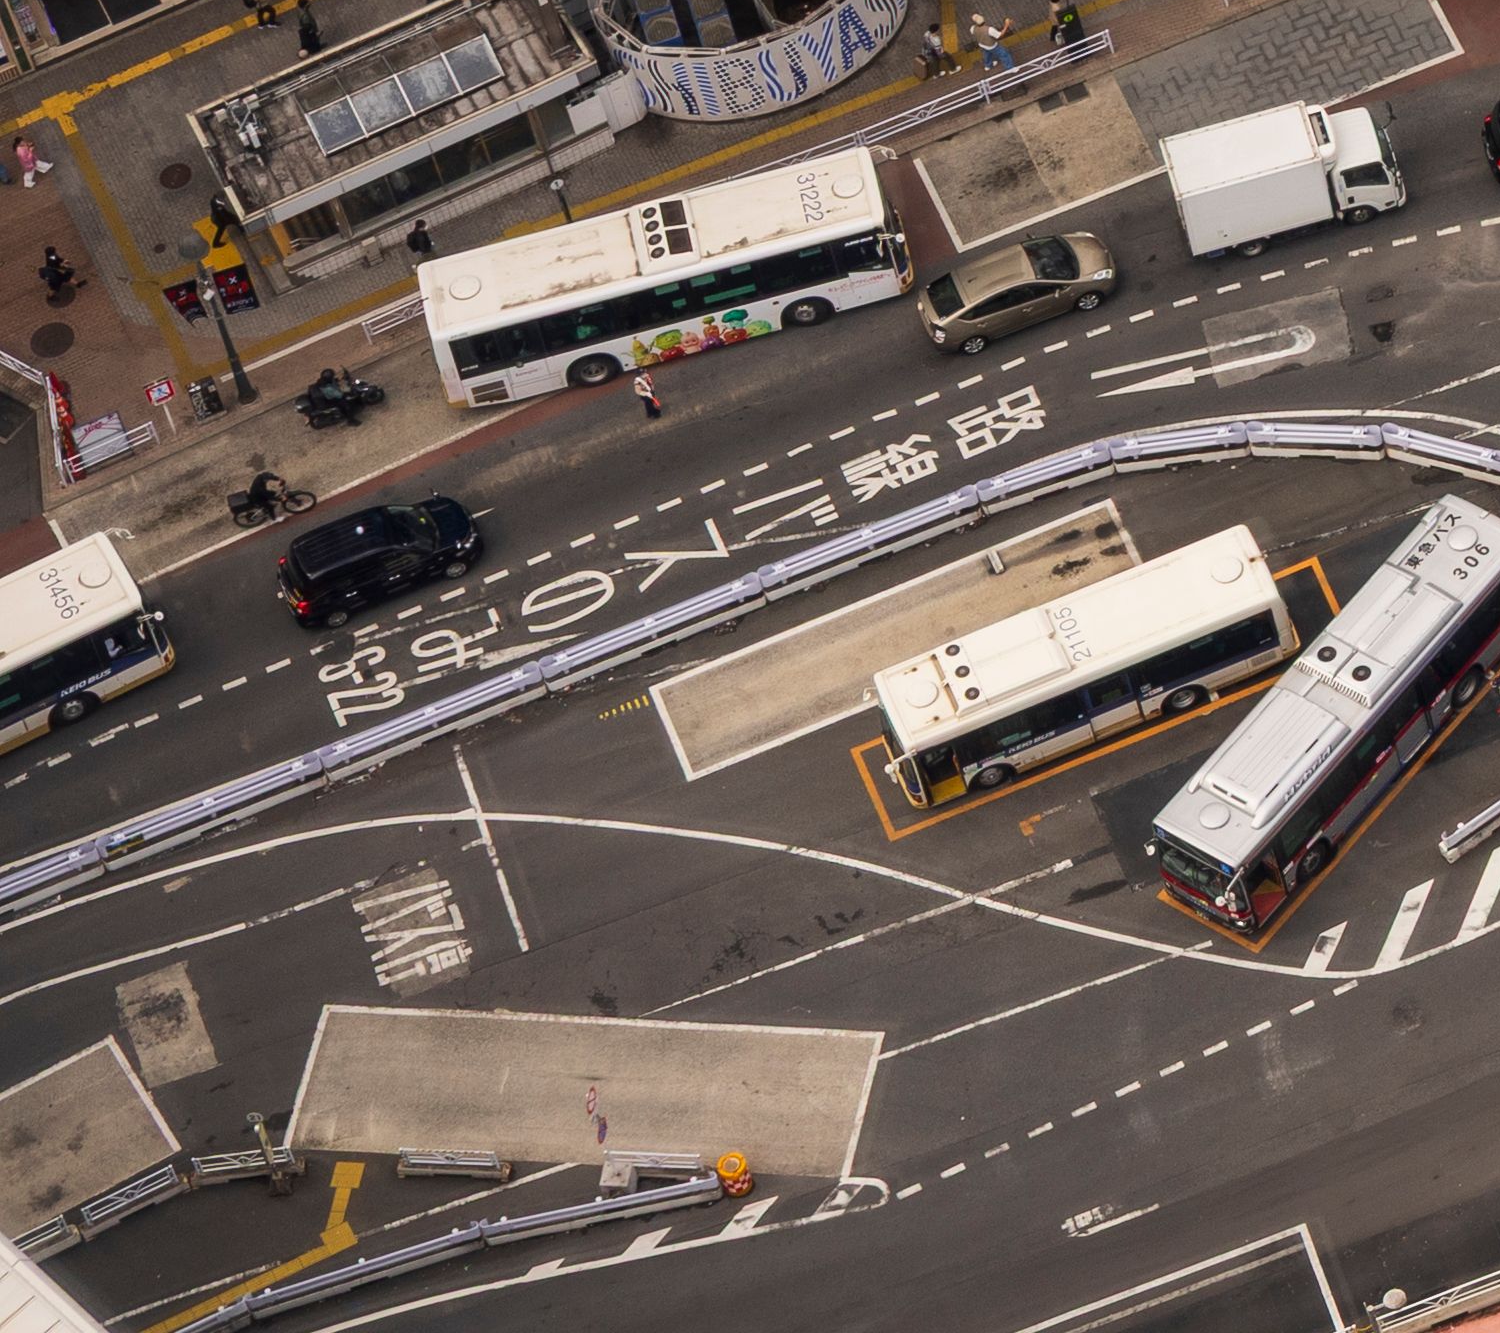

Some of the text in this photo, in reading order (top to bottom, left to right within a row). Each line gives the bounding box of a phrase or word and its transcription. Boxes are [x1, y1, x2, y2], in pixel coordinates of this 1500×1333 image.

[796, 171, 825, 223] 31222
[1403, 510, 1464, 570] 東急バス
[1453, 540, 1492, 582] 306
[38, 566, 80, 622] 31456
[1052, 604, 1093, 664] 21105
[59, 667, 113, 699] KEIO BUS
